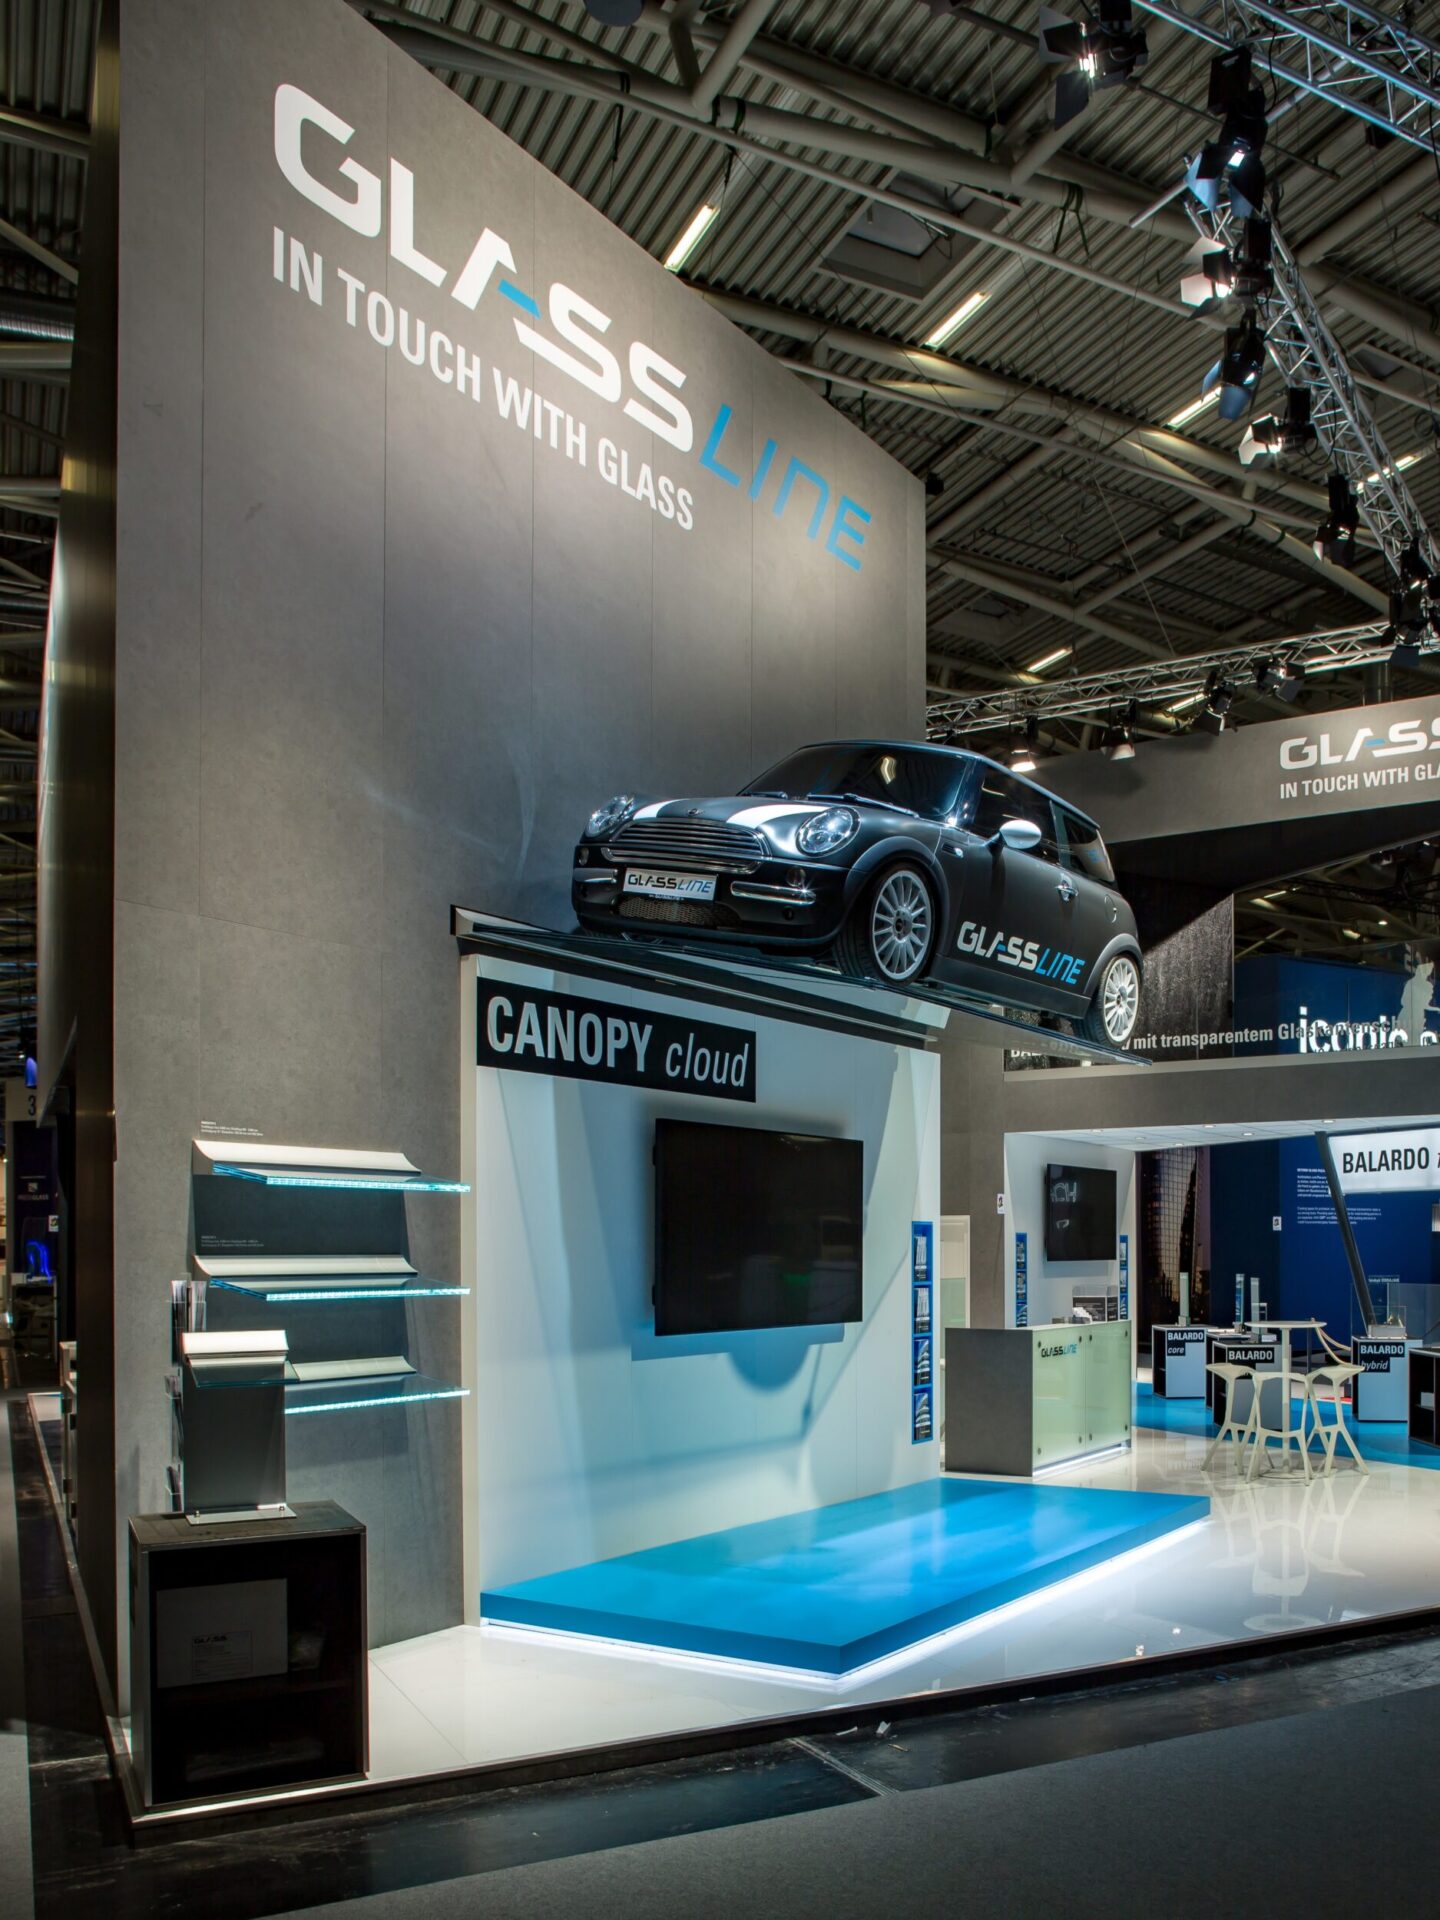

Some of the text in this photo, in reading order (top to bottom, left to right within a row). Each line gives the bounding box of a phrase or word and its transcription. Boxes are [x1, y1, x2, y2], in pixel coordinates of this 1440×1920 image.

[273, 225, 694, 531] IN TOUCH WITH GLASS
[1280, 781, 1298, 799] IN
[1301, 773, 1359, 796] TOUCH
[1363, 766, 1409, 788] WITH
[627, 874, 713, 893] GLASSLINE
[956, 920, 1086, 985] GLASSLINE
[487, 996, 750, 1087] CANOPY cloud
[1133, 1033, 1158, 1050] mit
[1160, 1027, 1273, 1050] transparentem
[1342, 1146, 1430, 1174] BALARDO
[1167, 1332, 1204, 1341] BALARDO
[1228, 1350, 1273, 1360] BALARDO
[1360, 1345, 1404, 1354] BALARDO
[1361, 1360, 1389, 1371] hybrid
